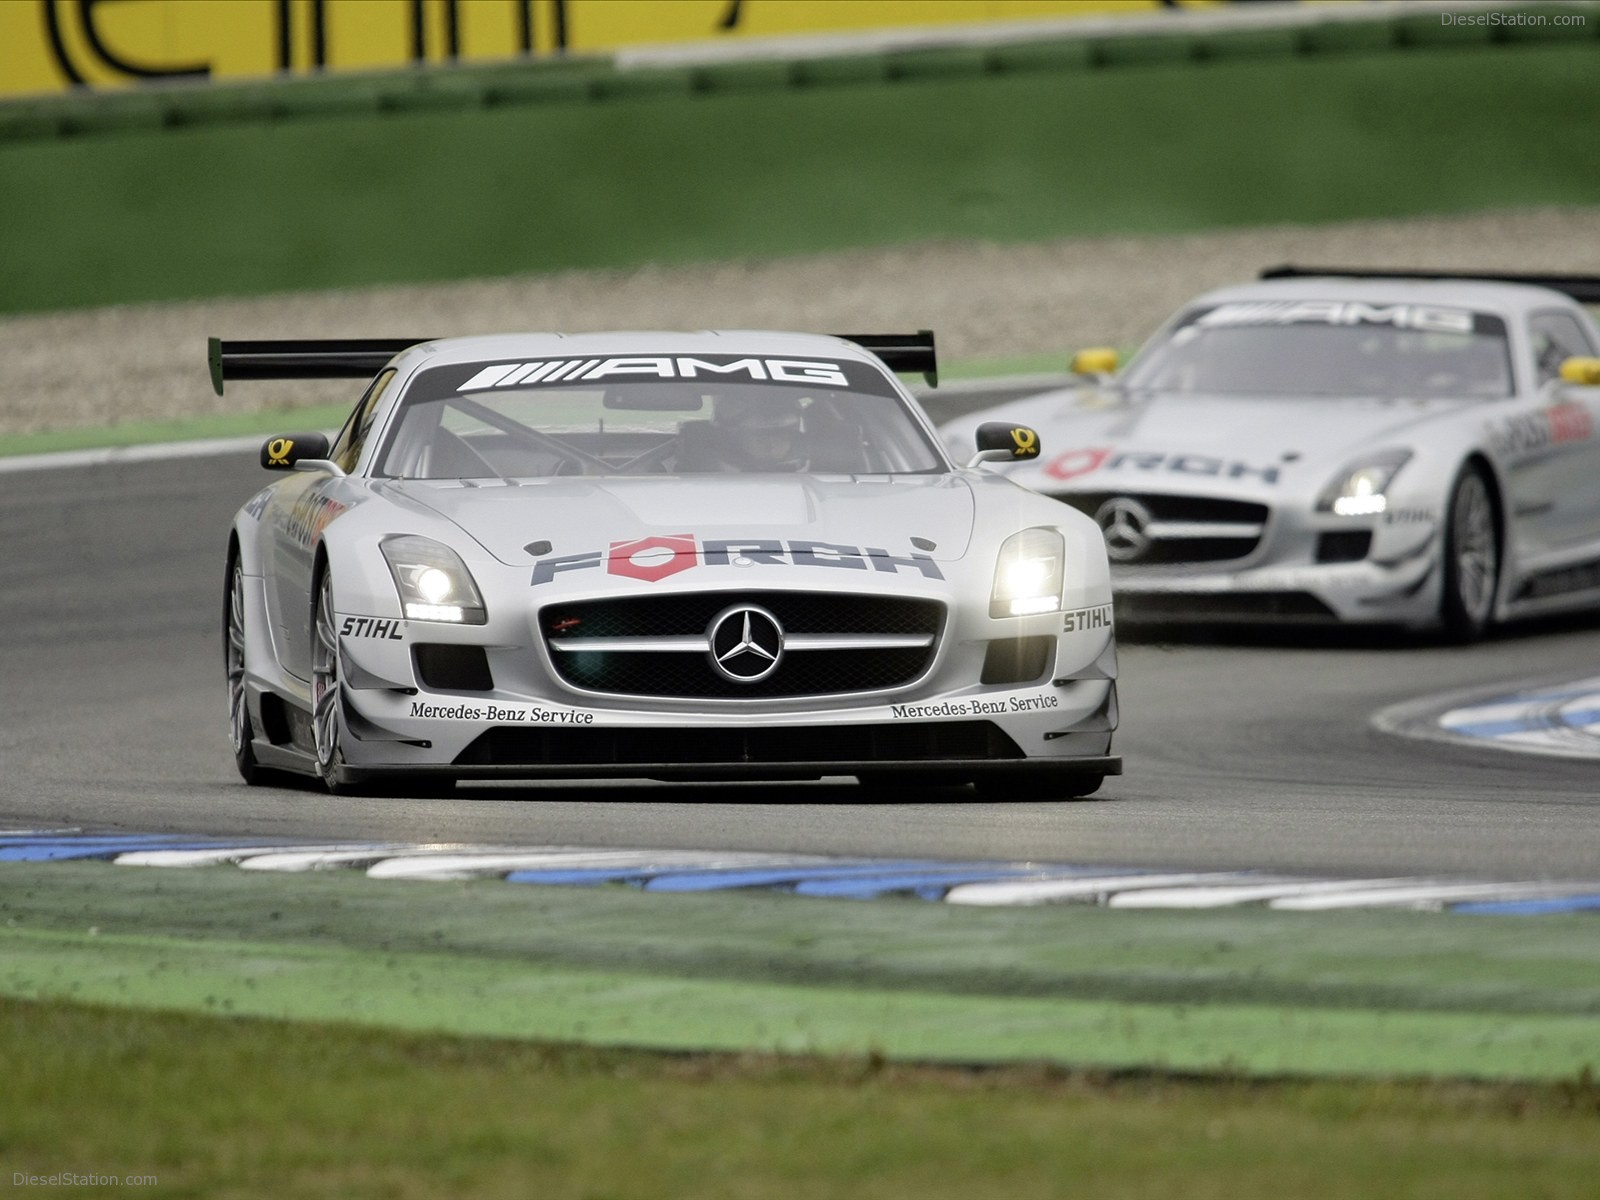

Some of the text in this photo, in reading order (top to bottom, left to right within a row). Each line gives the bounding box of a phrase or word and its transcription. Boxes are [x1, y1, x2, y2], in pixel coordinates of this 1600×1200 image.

[581, 357, 849, 387] AMG
[340, 617, 404, 641] STIHL
[1063, 606, 1111, 633] STIHL
[410, 702, 594, 724] Mercedes-Benz Service
[891, 694, 1059, 719] Mercedes-Benz Service
